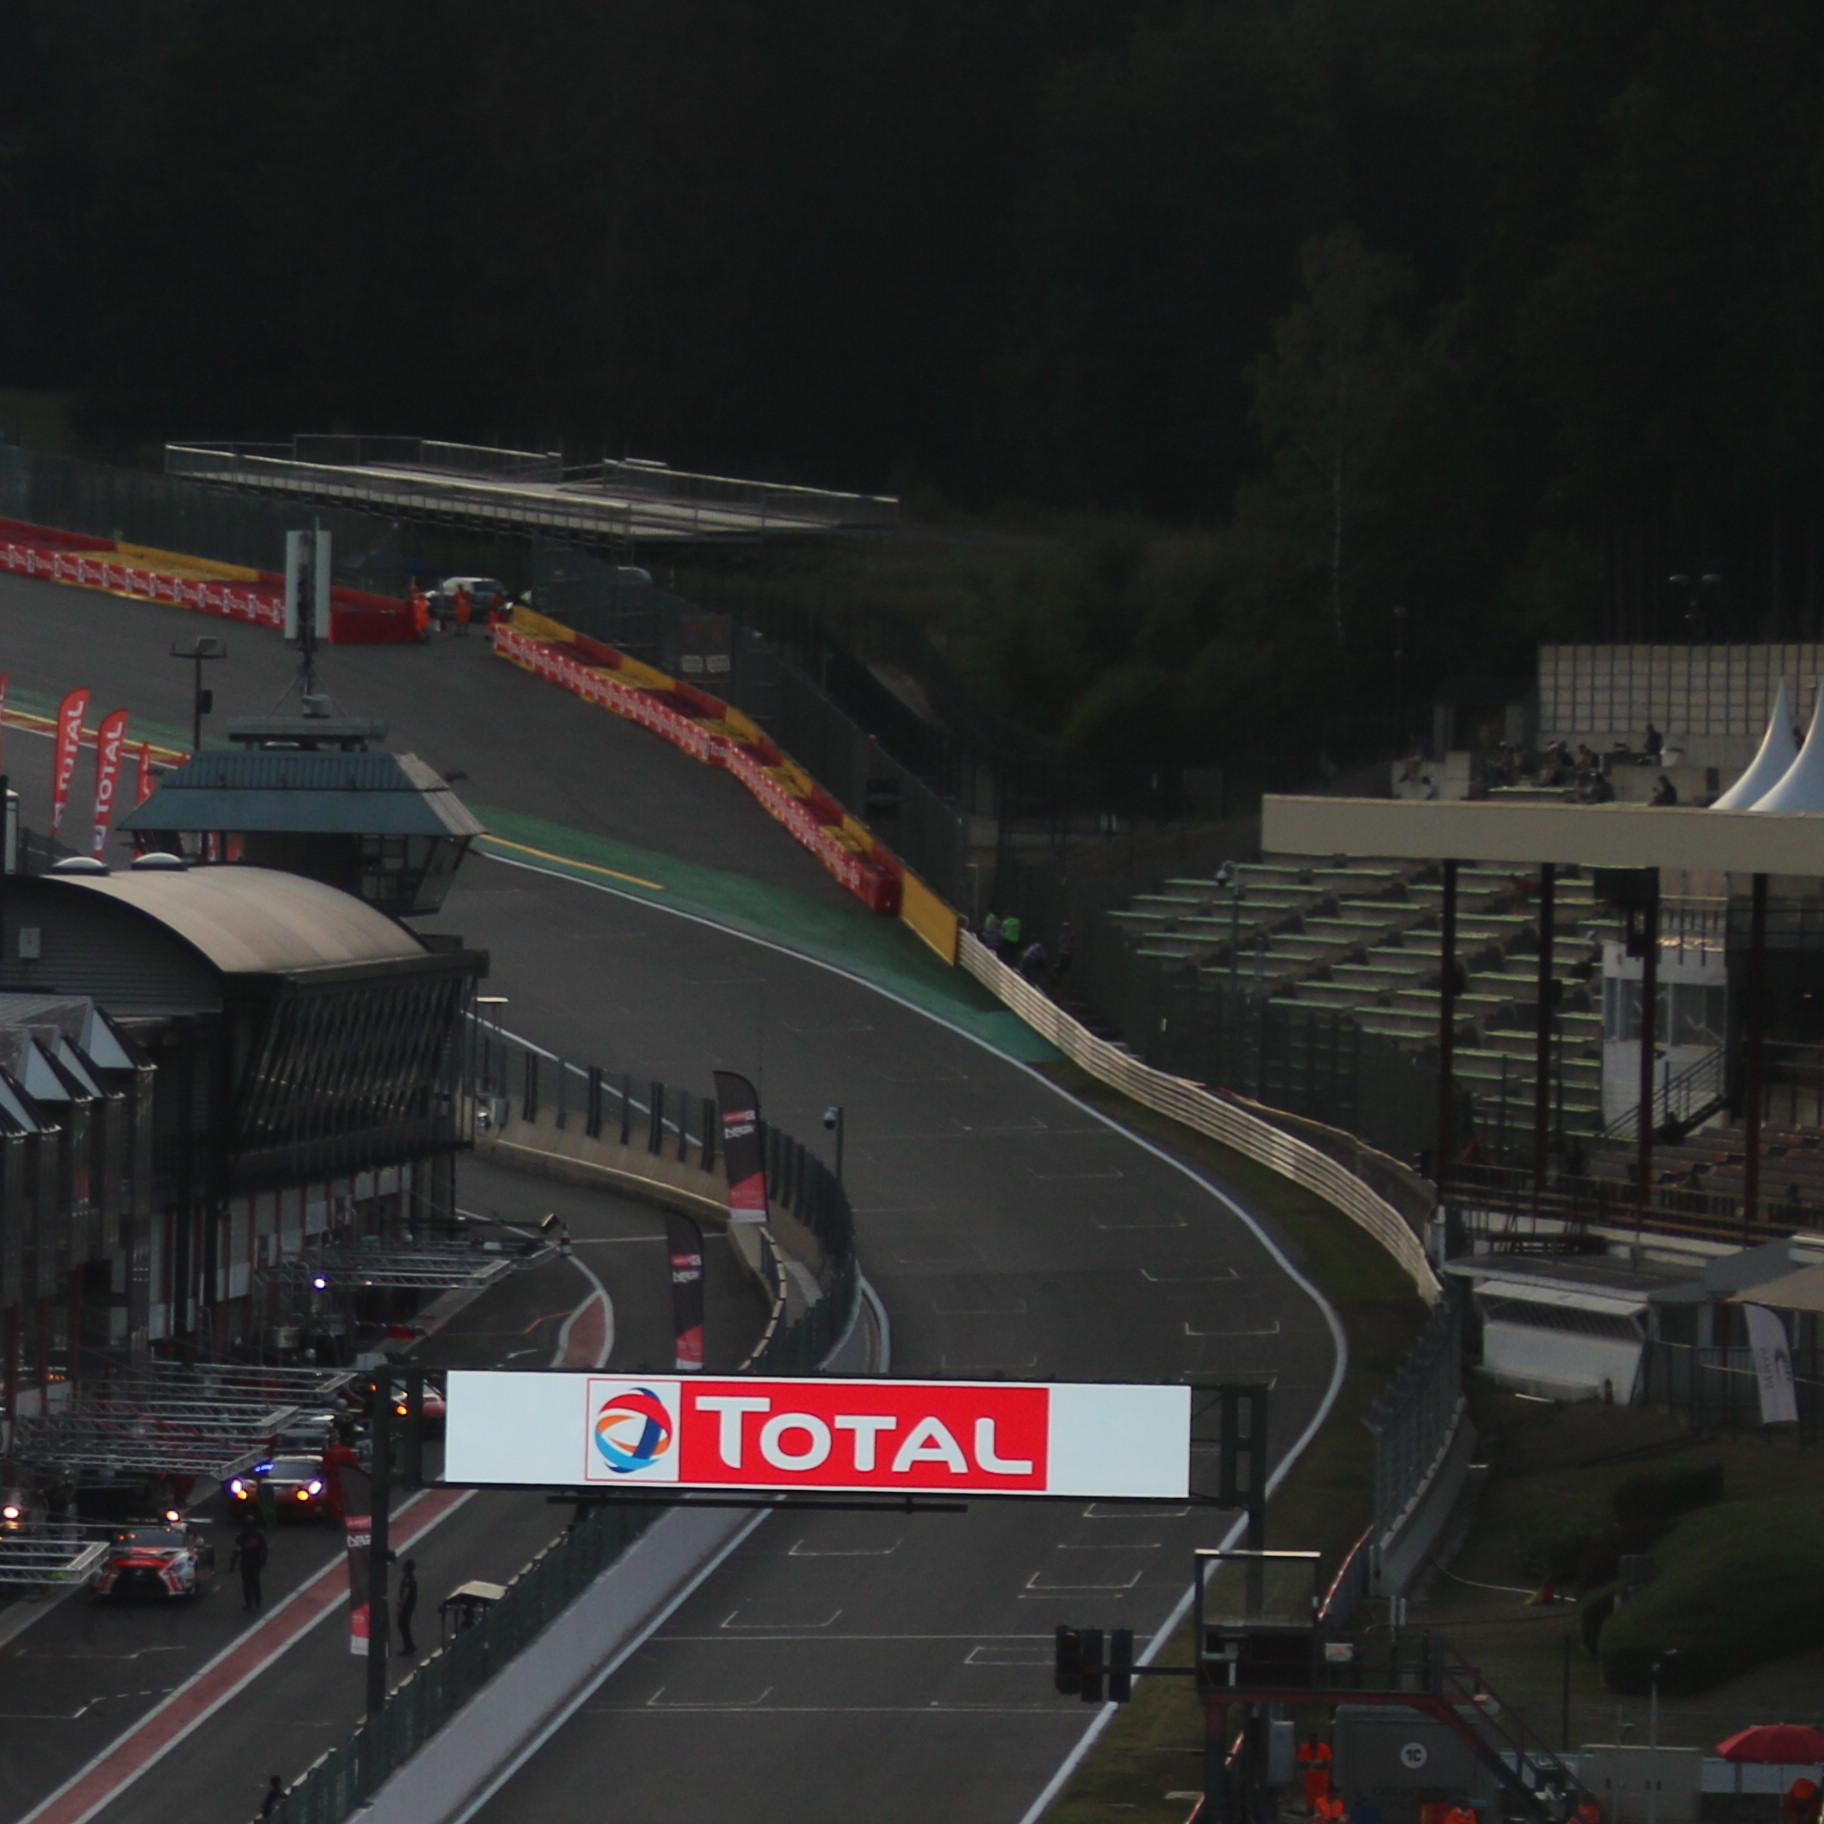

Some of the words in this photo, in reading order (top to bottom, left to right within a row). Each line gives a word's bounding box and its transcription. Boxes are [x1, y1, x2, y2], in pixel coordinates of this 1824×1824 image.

[56, 698, 85, 801] TOTAL
[96, 720, 124, 824] TOTAL
[694, 1395, 1033, 1476] TOTAL
[1405, 1749, 1422, 1762] 1C
